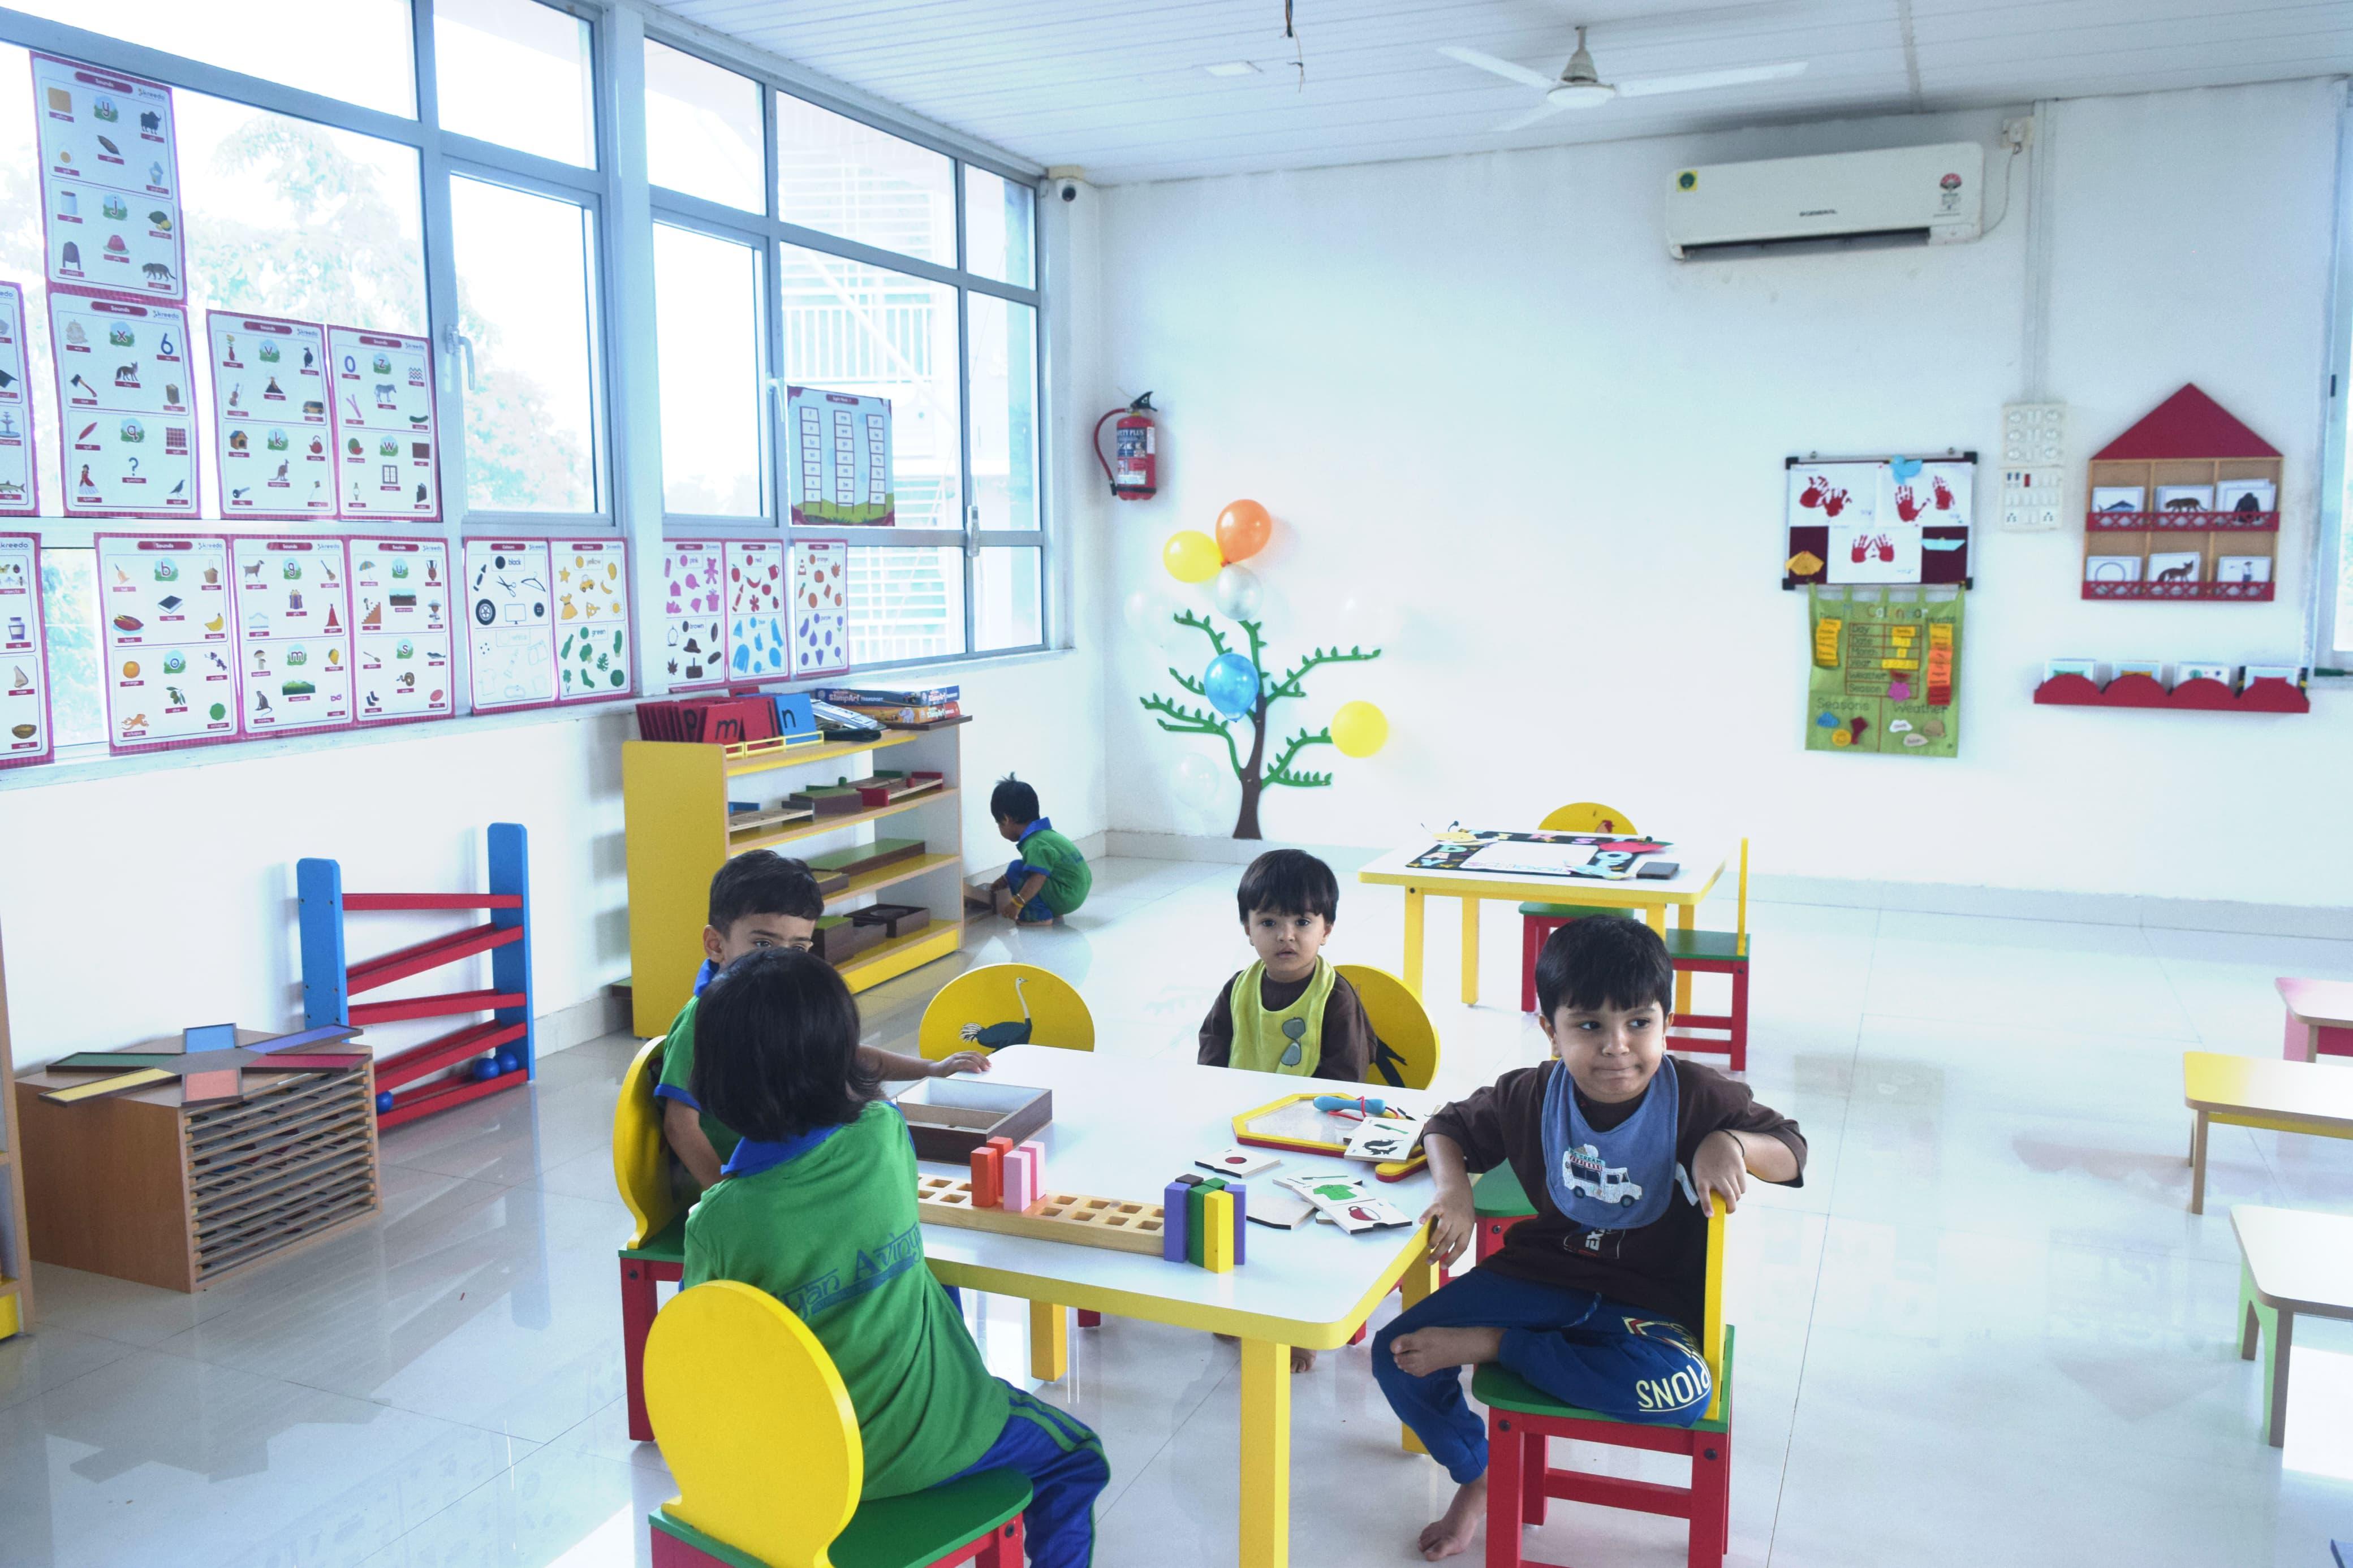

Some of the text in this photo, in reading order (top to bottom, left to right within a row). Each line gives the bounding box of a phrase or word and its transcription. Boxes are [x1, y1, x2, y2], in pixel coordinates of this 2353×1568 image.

[102, 100, 111, 117] y
[110, 196, 118, 215] j
[116, 330, 127, 343] x
[161, 332, 174, 355] 6
[265, 346, 274, 356] v
[126, 425, 139, 442] q
[274, 433, 282, 446] k
[384, 442, 394, 451] w
[161, 560, 171, 577] b
[287, 563, 296, 577] g
[395, 565, 403, 576] u
[291, 651, 304, 662] m
[402, 645, 408, 654] s
[781, 708, 796, 728] n
[715, 719, 738, 740] m
[1579, 1155, 1602, 1164] CREAM
[770, 1267, 842, 1321] yan
